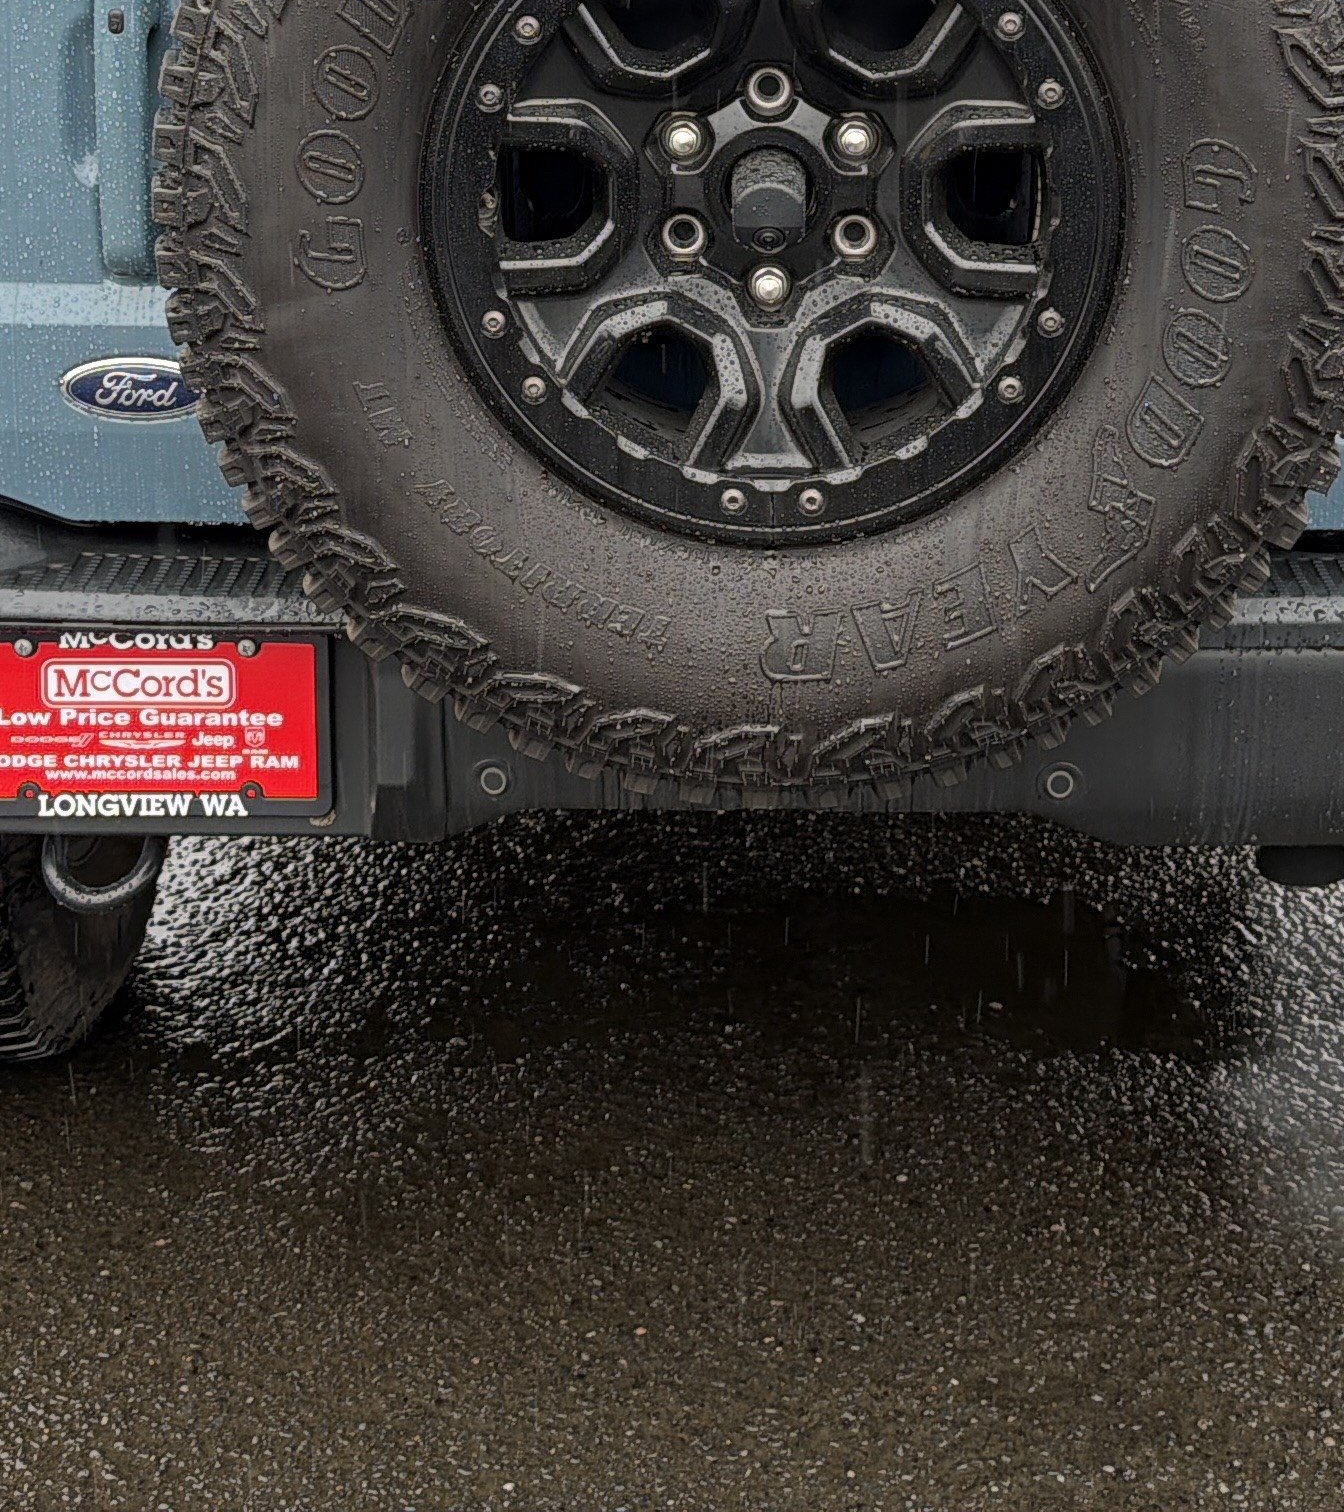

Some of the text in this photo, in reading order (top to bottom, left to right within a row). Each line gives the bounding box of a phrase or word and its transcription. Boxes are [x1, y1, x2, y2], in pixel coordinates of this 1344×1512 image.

[94, 371, 179, 407] Ford
[53, 668, 223, 698] McCord's
[60, 708, 132, 727] Price
[139, 709, 284, 728] Guarantee
[191, 731, 235, 750] Jeep
[63, 754, 182, 769] CHRYSLER
[187, 755, 244, 769] JEEP
[250, 755, 300, 769] RAM
[45, 769, 237, 781] www.mccordsales.com
[37, 793, 249, 817] LONGVIEW WA
